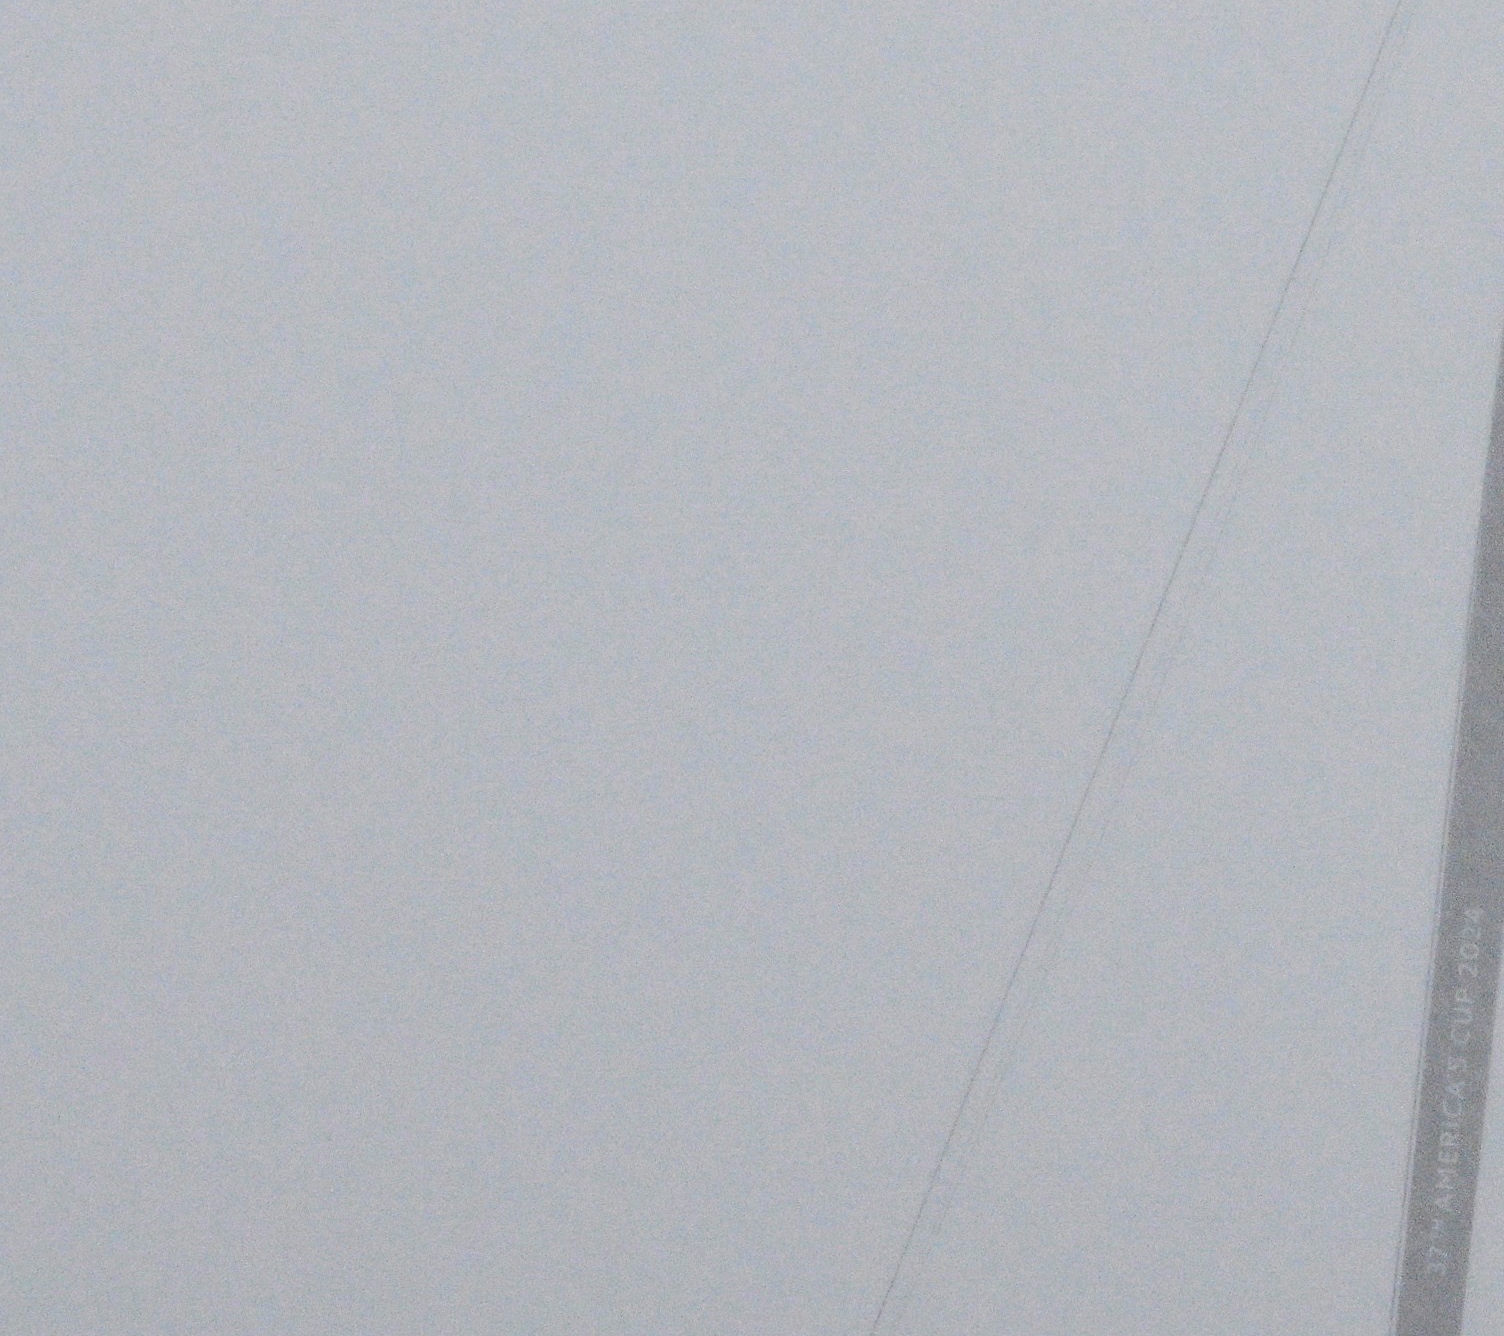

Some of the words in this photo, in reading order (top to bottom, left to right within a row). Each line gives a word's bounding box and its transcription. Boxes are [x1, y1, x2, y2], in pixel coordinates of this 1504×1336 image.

[1457, 906, 1485, 979] 2024
[1449, 986, 1476, 1047] CUP
[1433, 1055, 1468, 1213] AMERICA'S
